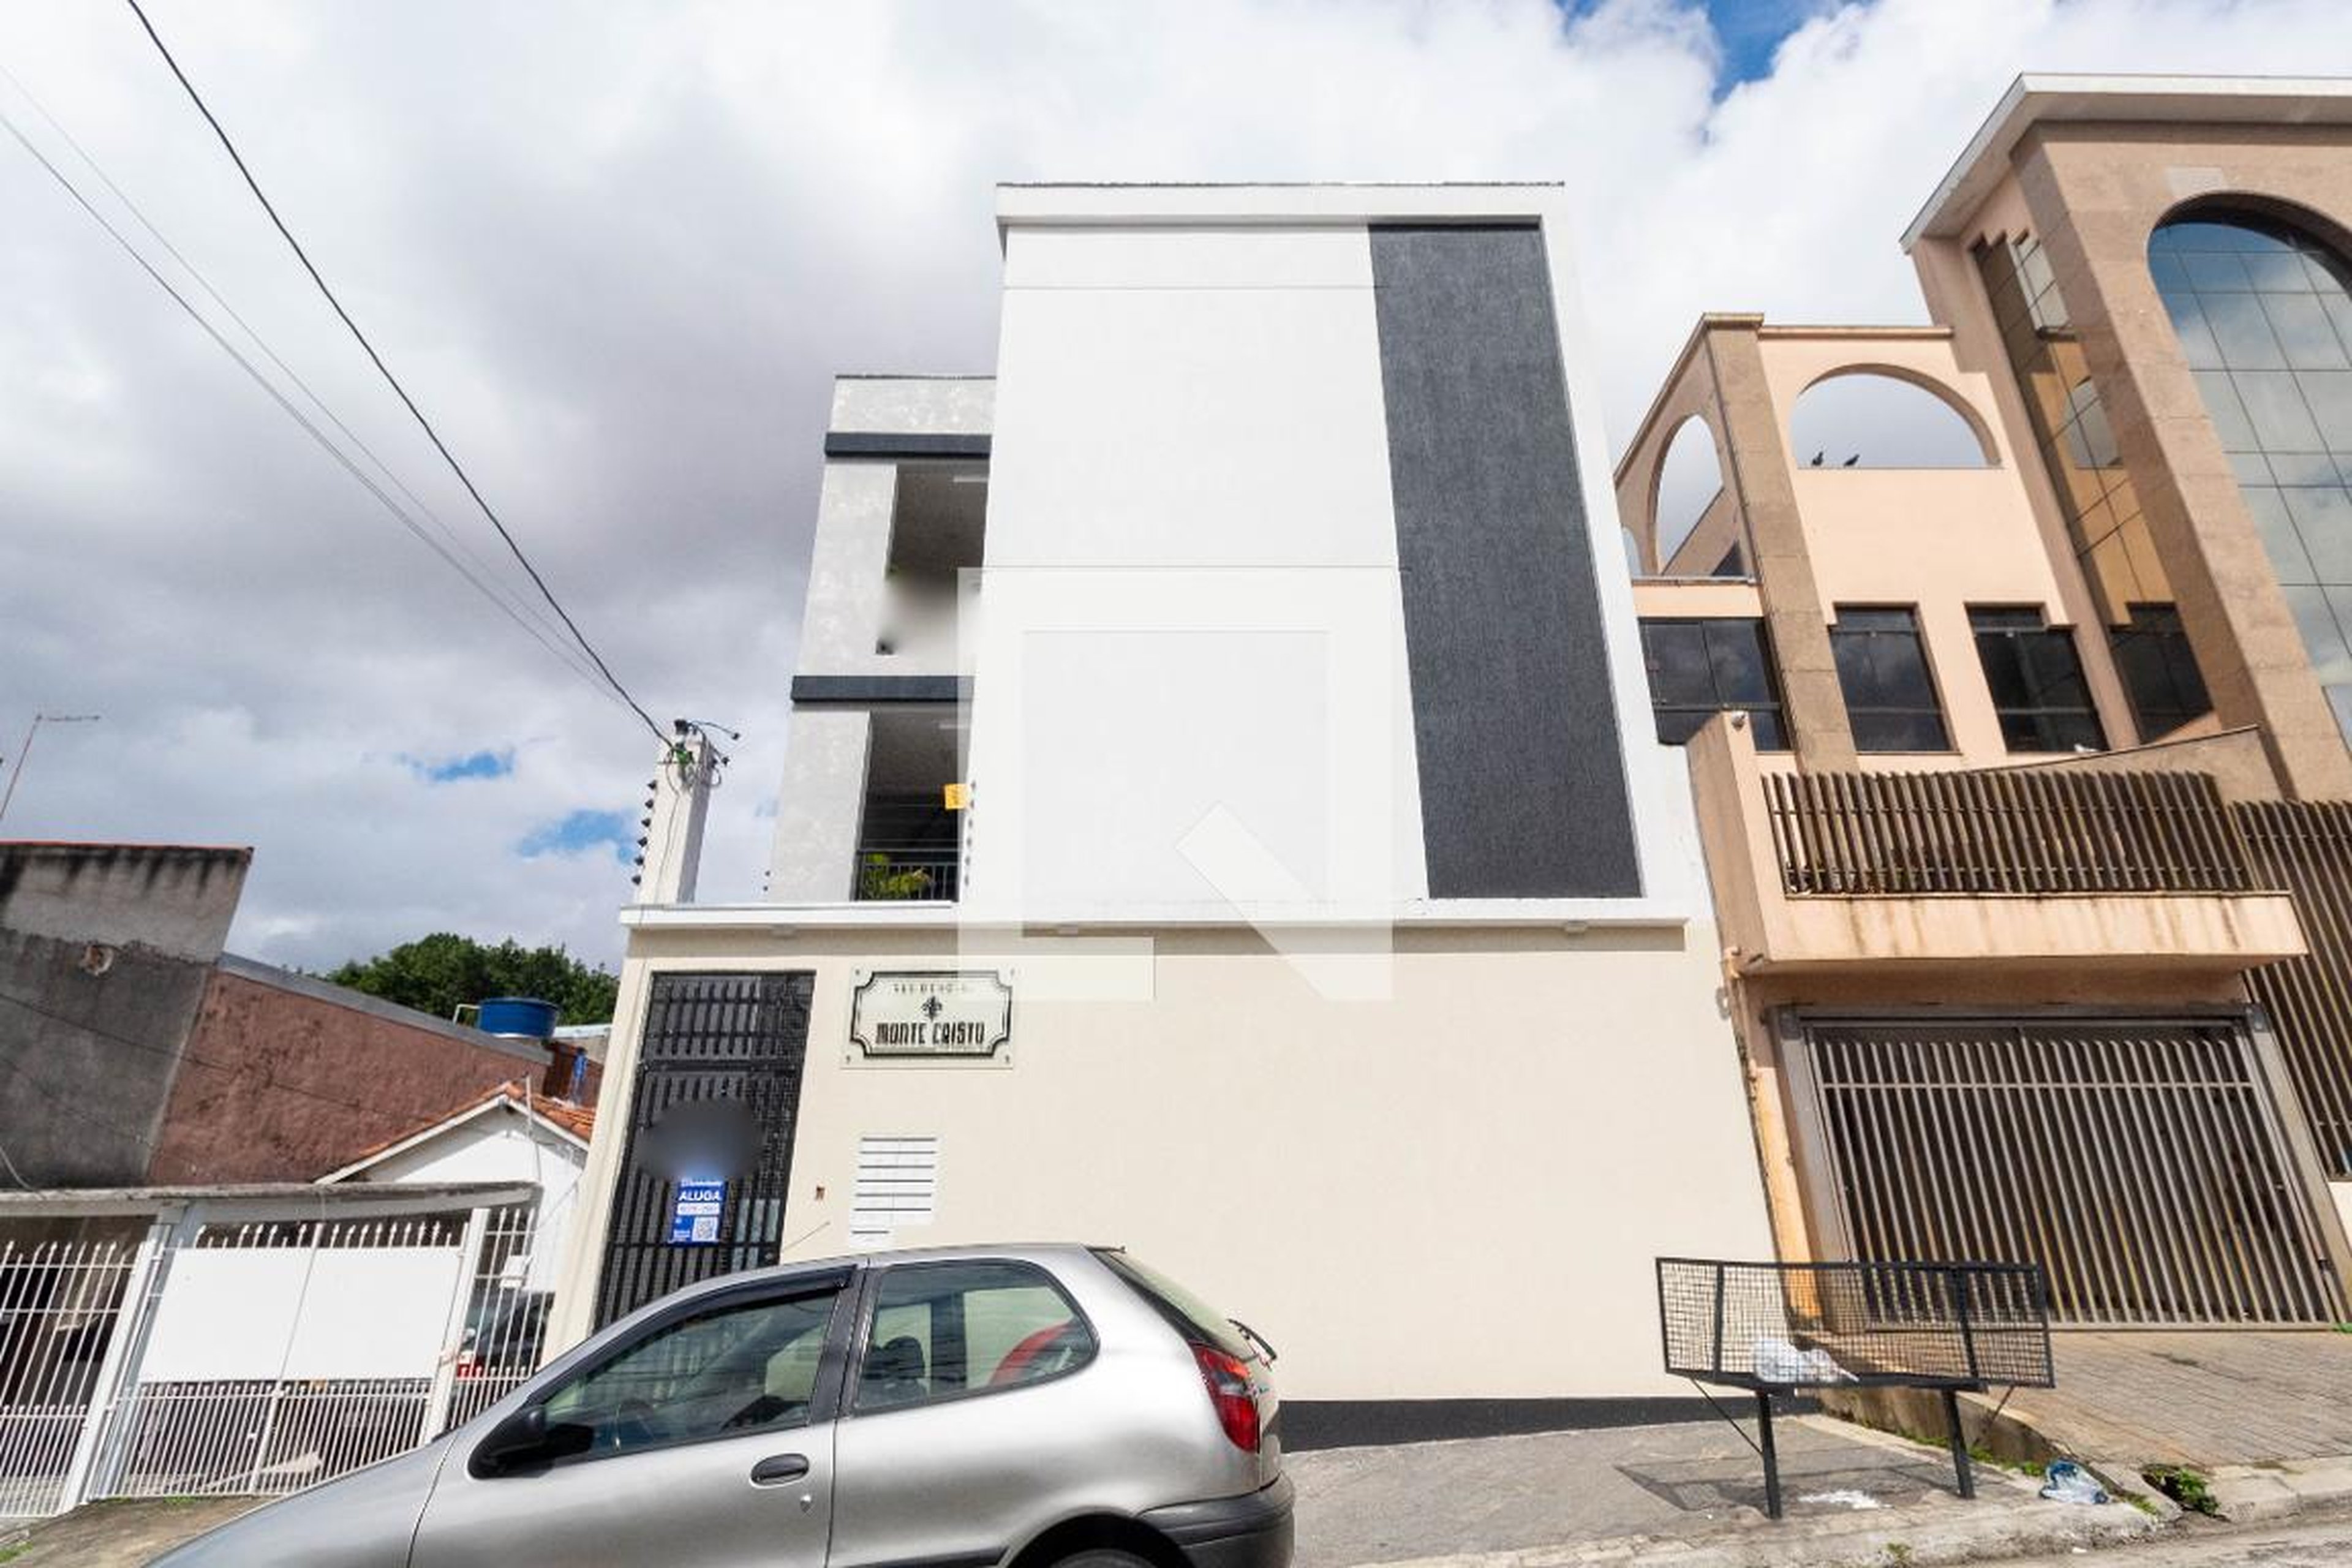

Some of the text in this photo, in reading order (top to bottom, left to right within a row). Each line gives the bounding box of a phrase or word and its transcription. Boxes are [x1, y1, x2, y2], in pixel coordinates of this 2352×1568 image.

[875, 1021, 985, 1045] MONTE CRISTO
[679, 1190, 722, 1201] ALUGA
